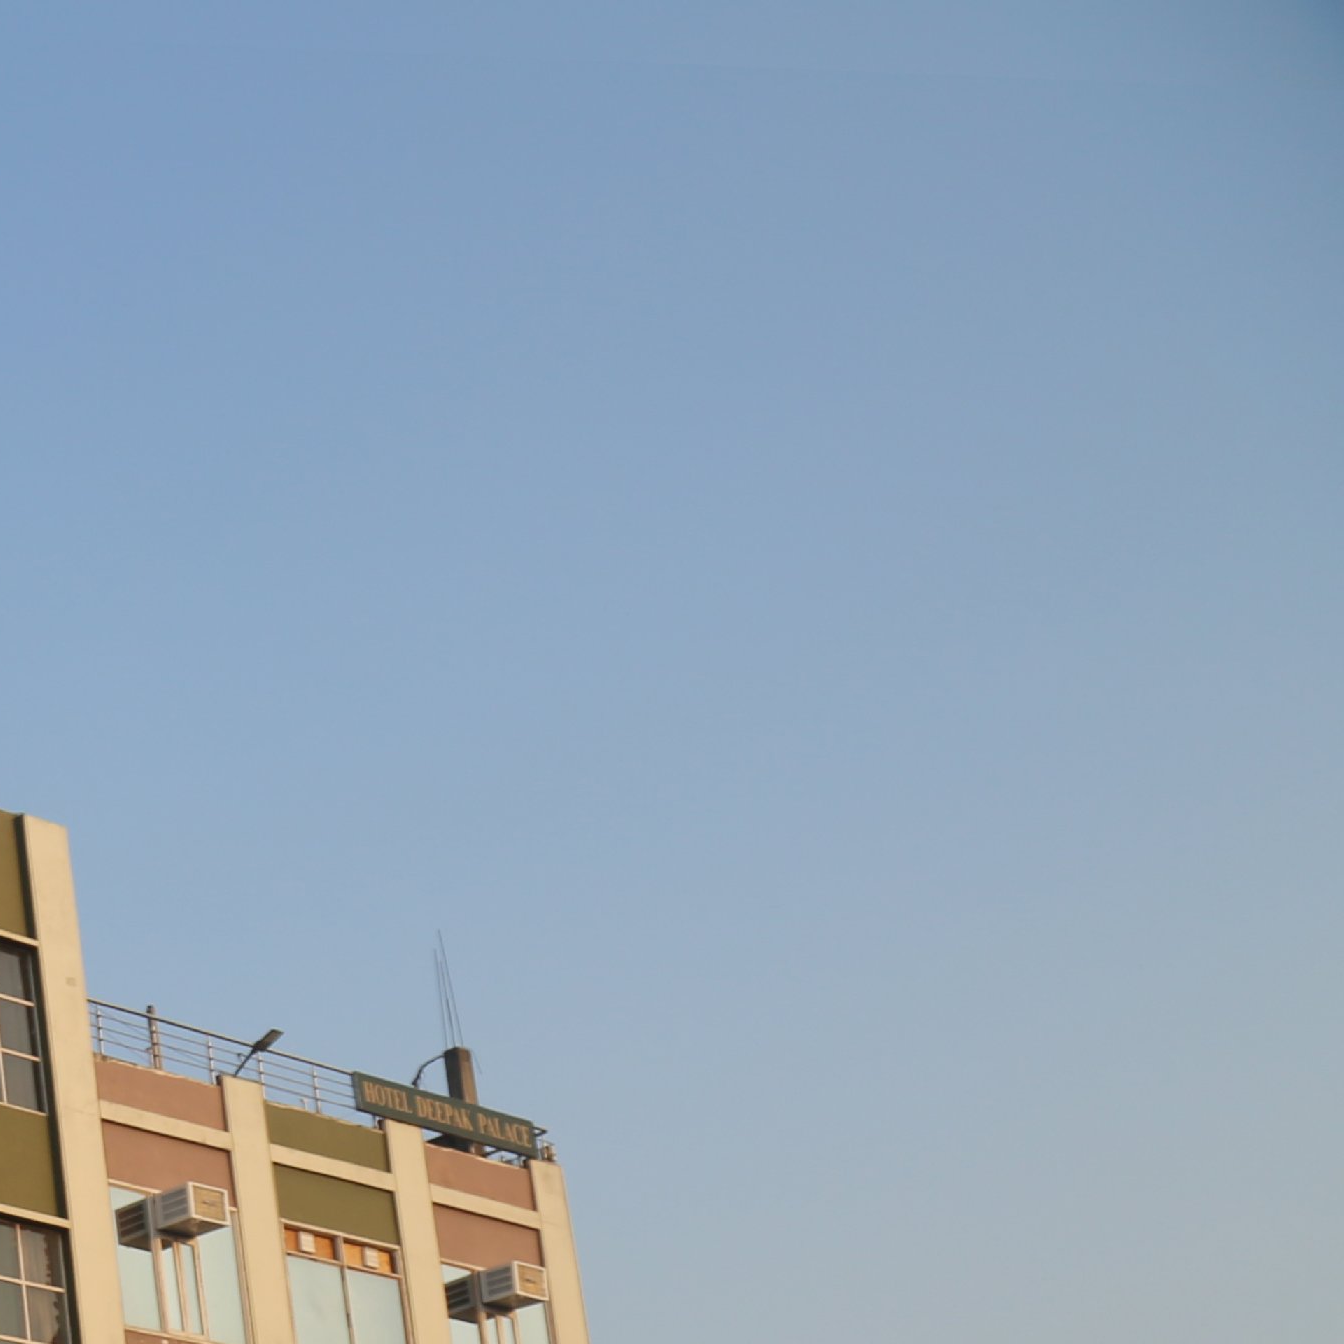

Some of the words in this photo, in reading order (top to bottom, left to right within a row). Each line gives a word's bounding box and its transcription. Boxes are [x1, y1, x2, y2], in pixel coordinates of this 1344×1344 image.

[363, 1081, 413, 1114] HOTEL
[416, 1096, 474, 1131] DEEPAK
[477, 1113, 533, 1148] PALACE
